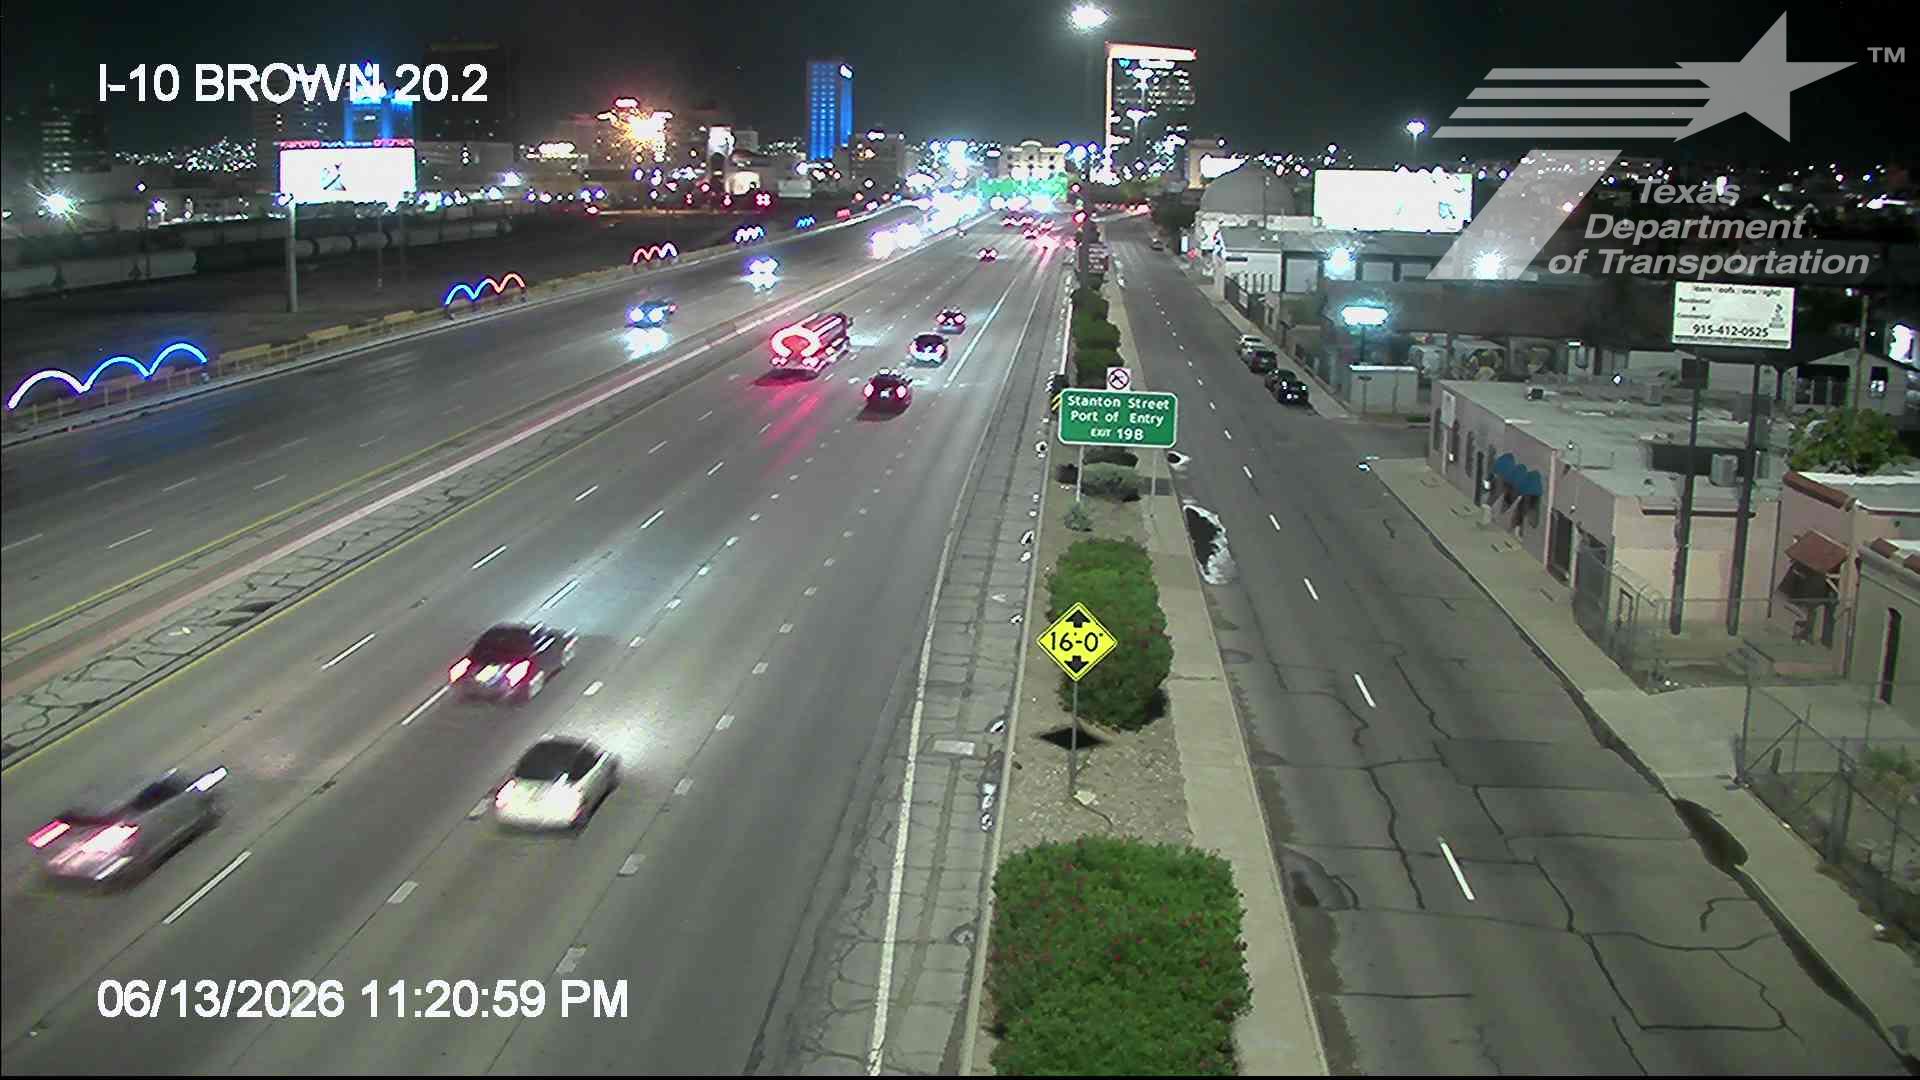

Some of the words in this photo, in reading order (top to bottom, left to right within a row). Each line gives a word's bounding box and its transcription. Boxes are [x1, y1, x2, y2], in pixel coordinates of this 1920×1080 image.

[1692, 323, 1769, 338] 915-412-0525
[1067, 395, 1121, 408] Stanton
[1128, 396, 1170, 410] Street
[1070, 410, 1098, 422] Port
[1105, 411, 1120, 423] of
[1129, 412, 1164, 428] Entry
[1091, 428, 1112, 438] EXIT
